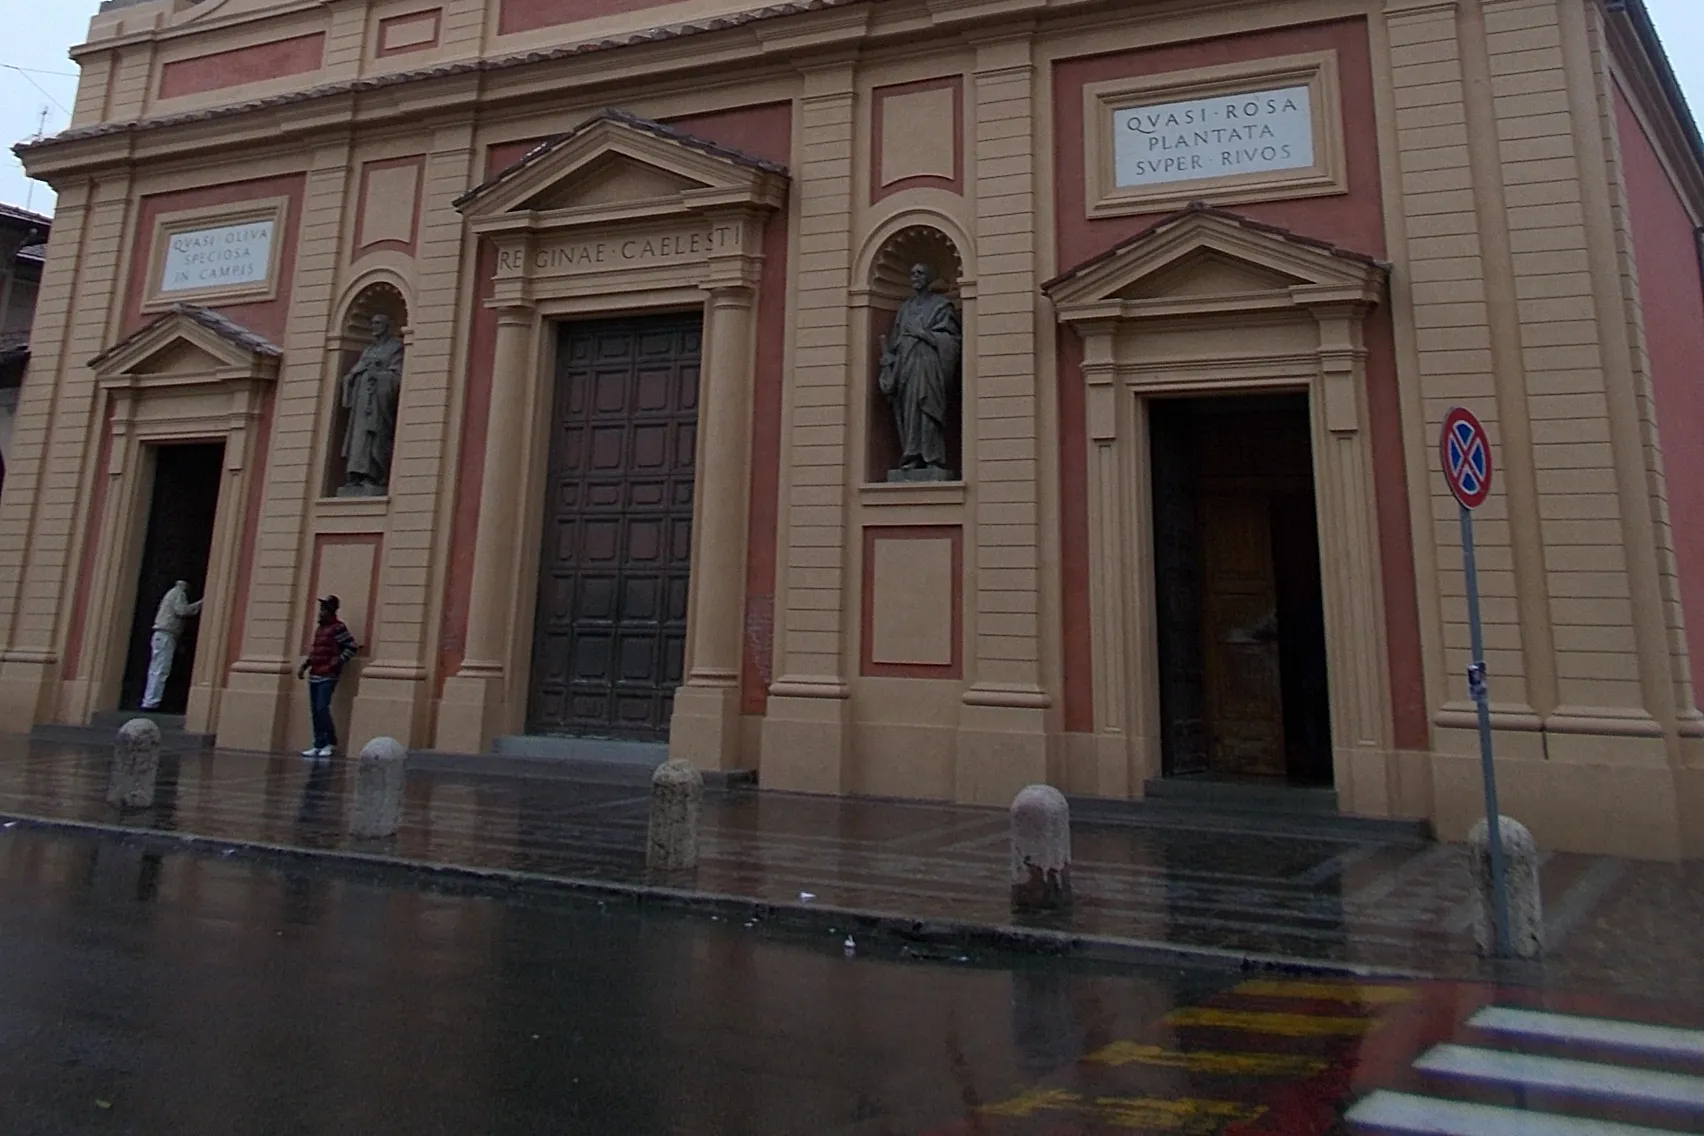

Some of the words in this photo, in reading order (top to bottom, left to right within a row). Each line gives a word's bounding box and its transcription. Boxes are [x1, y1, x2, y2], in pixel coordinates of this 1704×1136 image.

[1126, 108, 1203, 133] QVASI
[1225, 98, 1298, 120] ROSA
[1148, 124, 1275, 152] PLANTATA
[1135, 154, 1204, 176] SVPER
[1221, 144, 1292, 166] RIVOS
[174, 235, 215, 252] QVASI
[225, 228, 268, 244] OLIVA
[500, 243, 605, 270] REGINAE
[621, 225, 740, 260] CAELESTI
[184, 249, 251, 266] SPECIOSA
[174, 271, 189, 283] IN
[199, 264, 254, 280] CAMPIS
